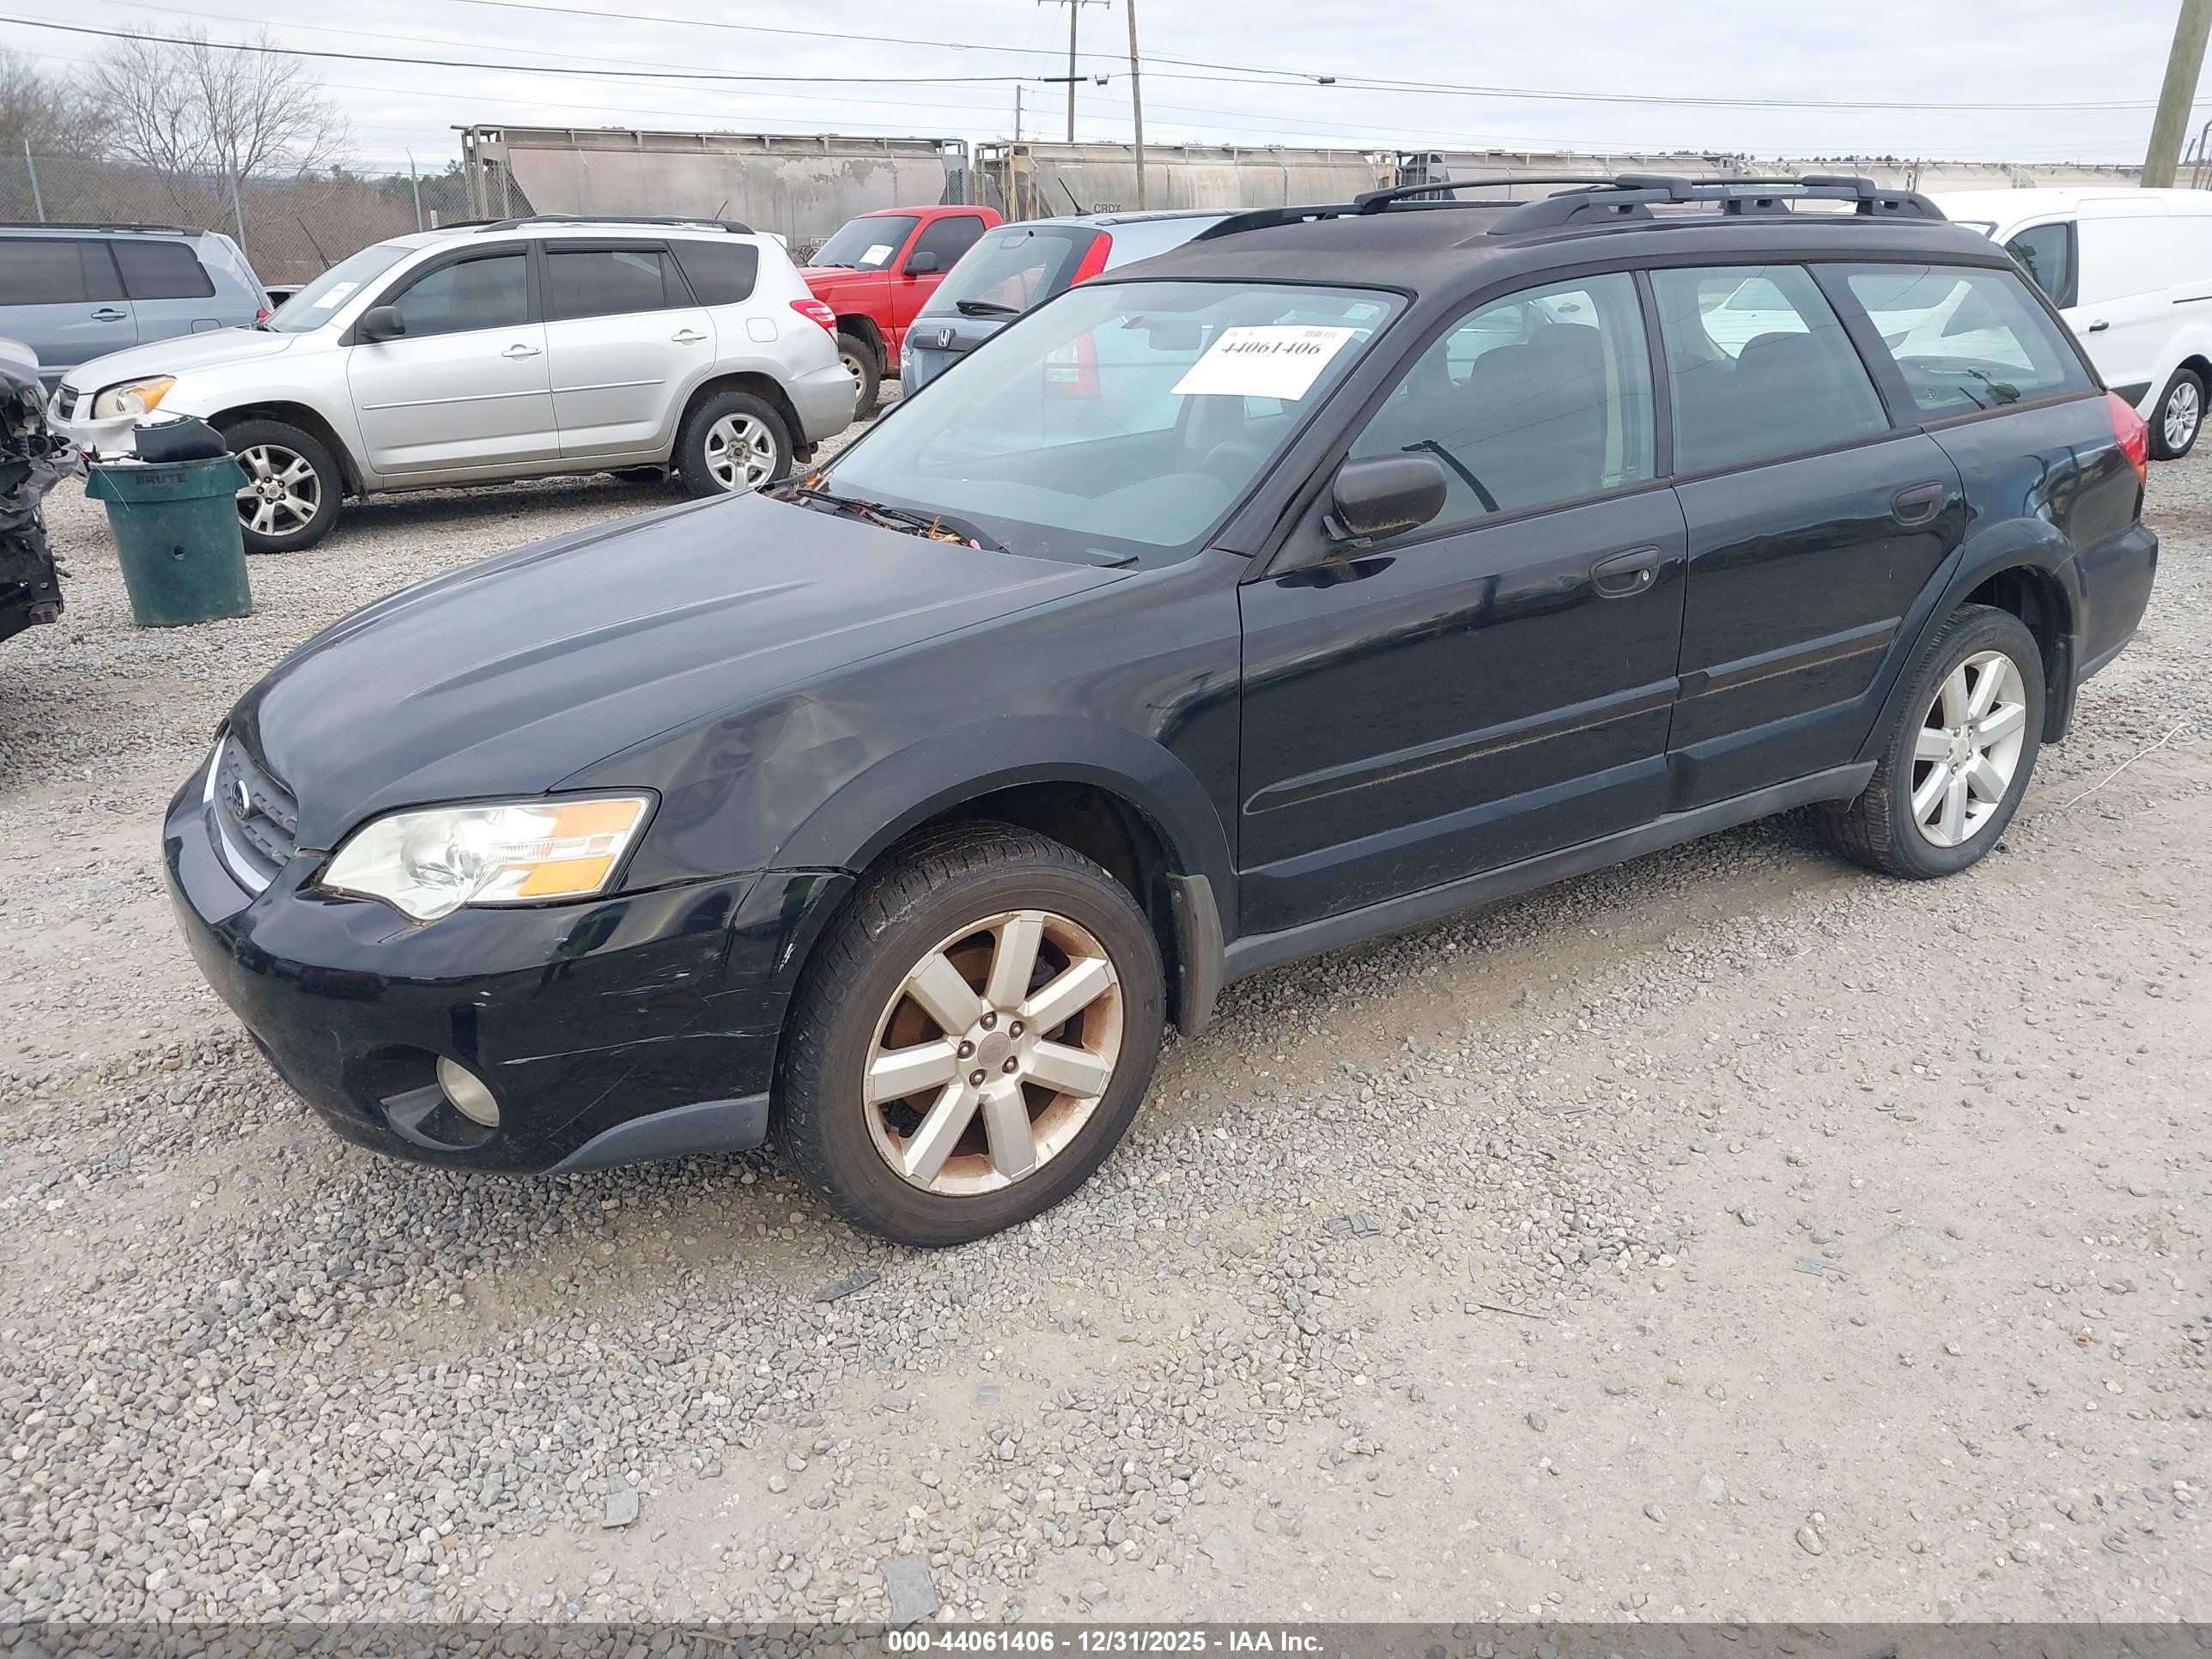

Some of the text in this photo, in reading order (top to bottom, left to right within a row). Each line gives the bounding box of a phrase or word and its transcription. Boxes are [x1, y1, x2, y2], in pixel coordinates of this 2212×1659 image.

[1093, 204, 1121, 214] CRDX
[1221, 341, 1322, 356] 44061406
[135, 472, 188, 485] BRUTE
